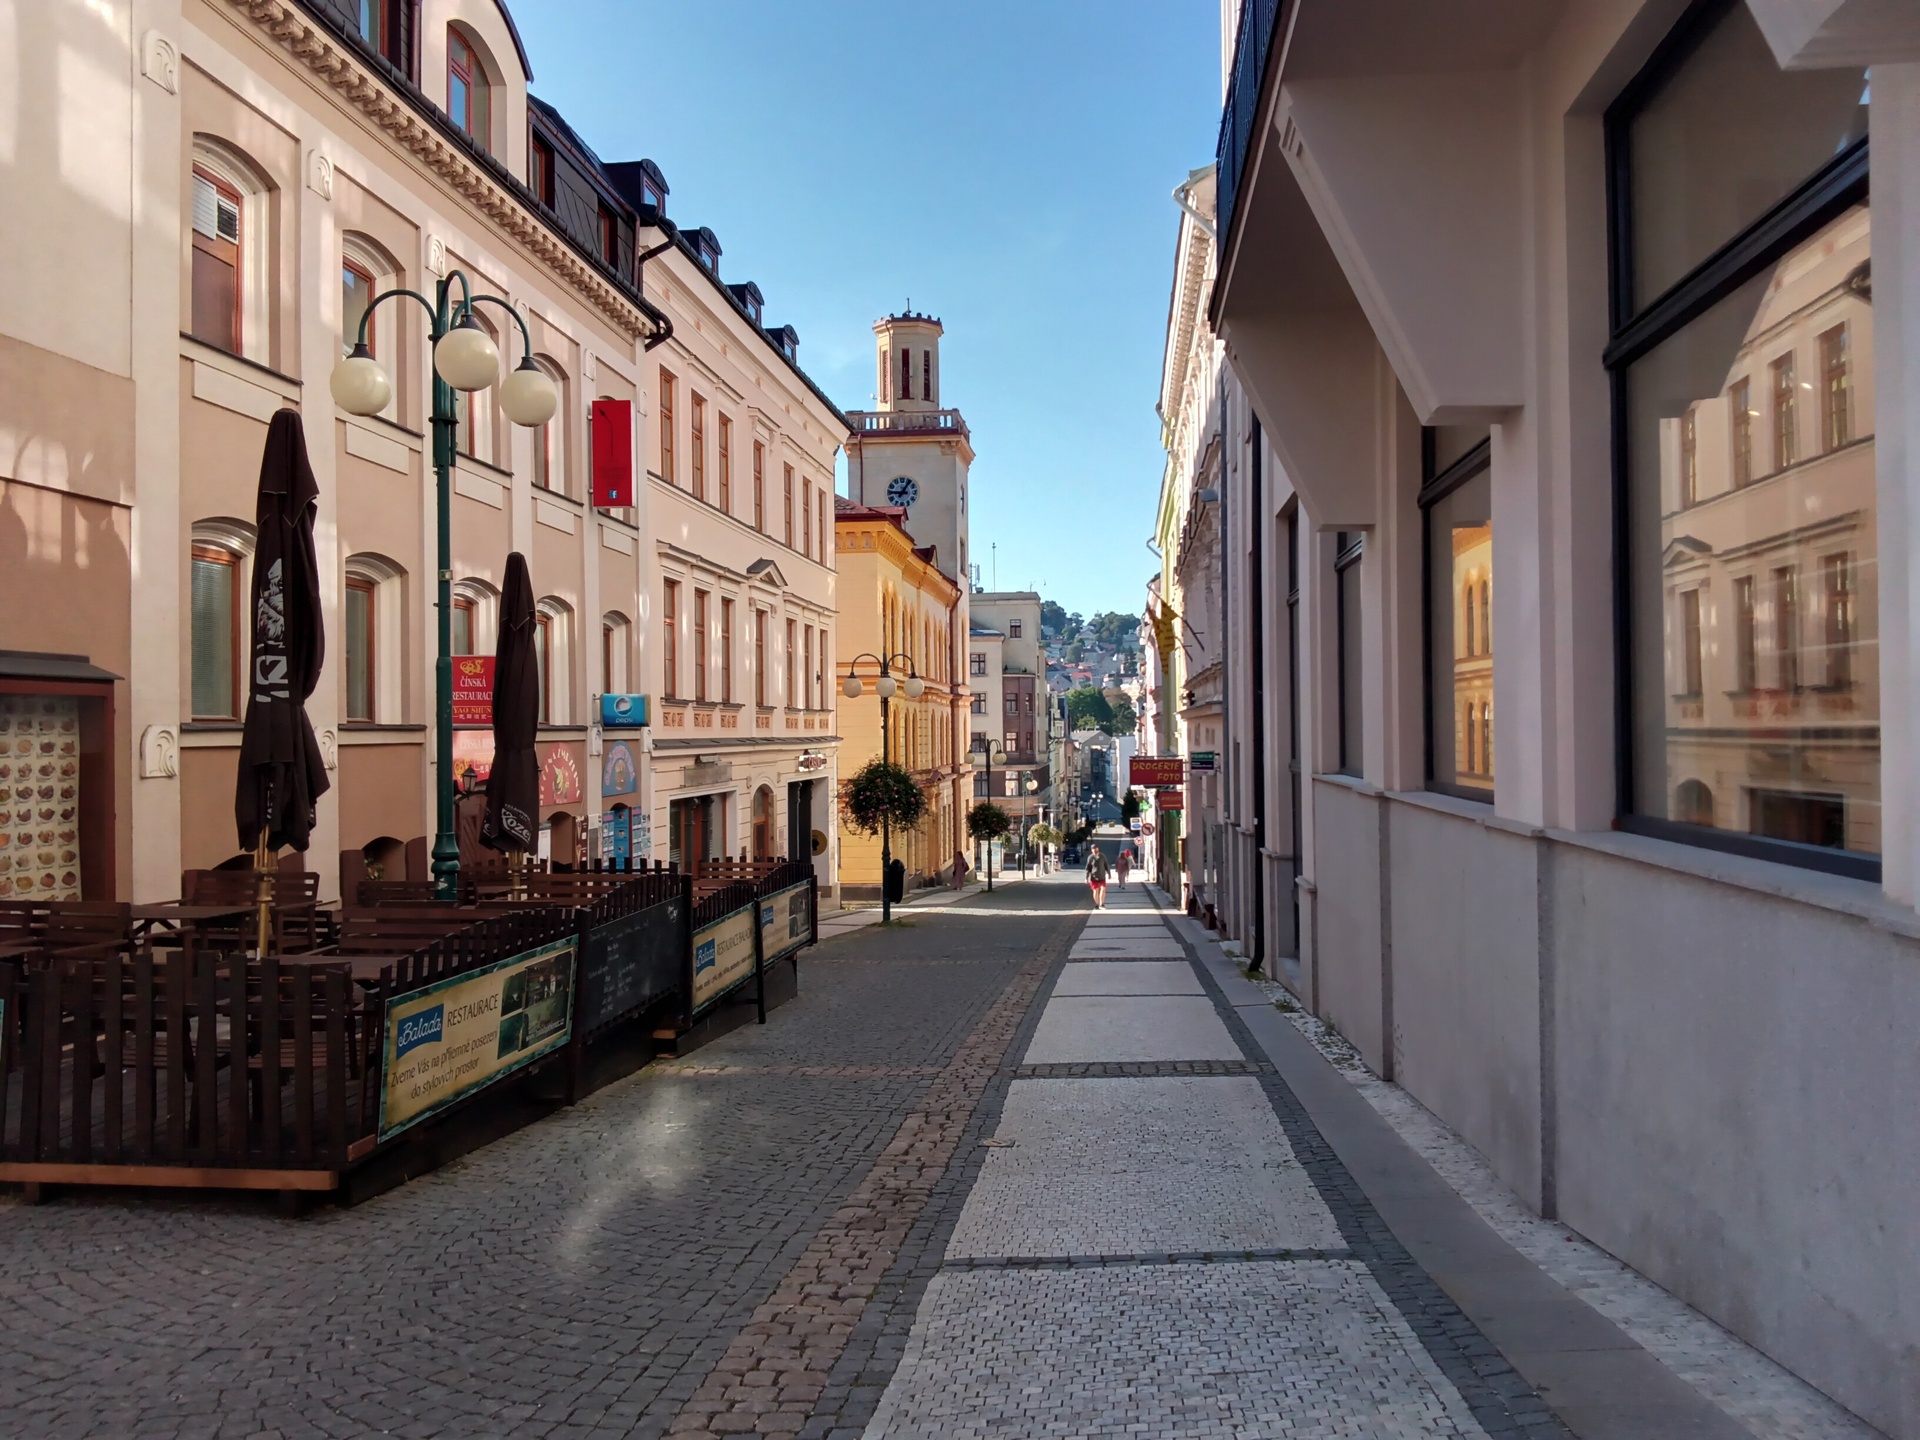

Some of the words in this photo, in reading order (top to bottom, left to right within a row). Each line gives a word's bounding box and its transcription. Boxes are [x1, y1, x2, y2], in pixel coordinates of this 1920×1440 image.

[460, 675, 487, 687] ČÍNSKÁ
[453, 706, 469, 714] YAO
[1132, 761, 1181, 771] DROGERIE
[1157, 772, 1181, 781] FOTO
[397, 1011, 442, 1048] Balada
[446, 993, 500, 1028] RESTAURACE
[390, 1066, 416, 1089] Zveme
[417, 1058, 430, 1074] Vás
[430, 1057, 441, 1068] na
[440, 1041, 471, 1066] příjemné
[411, 1085, 422, 1099] do
[422, 1070, 454, 1096] stylových
[454, 1056, 480, 1081] prostor
